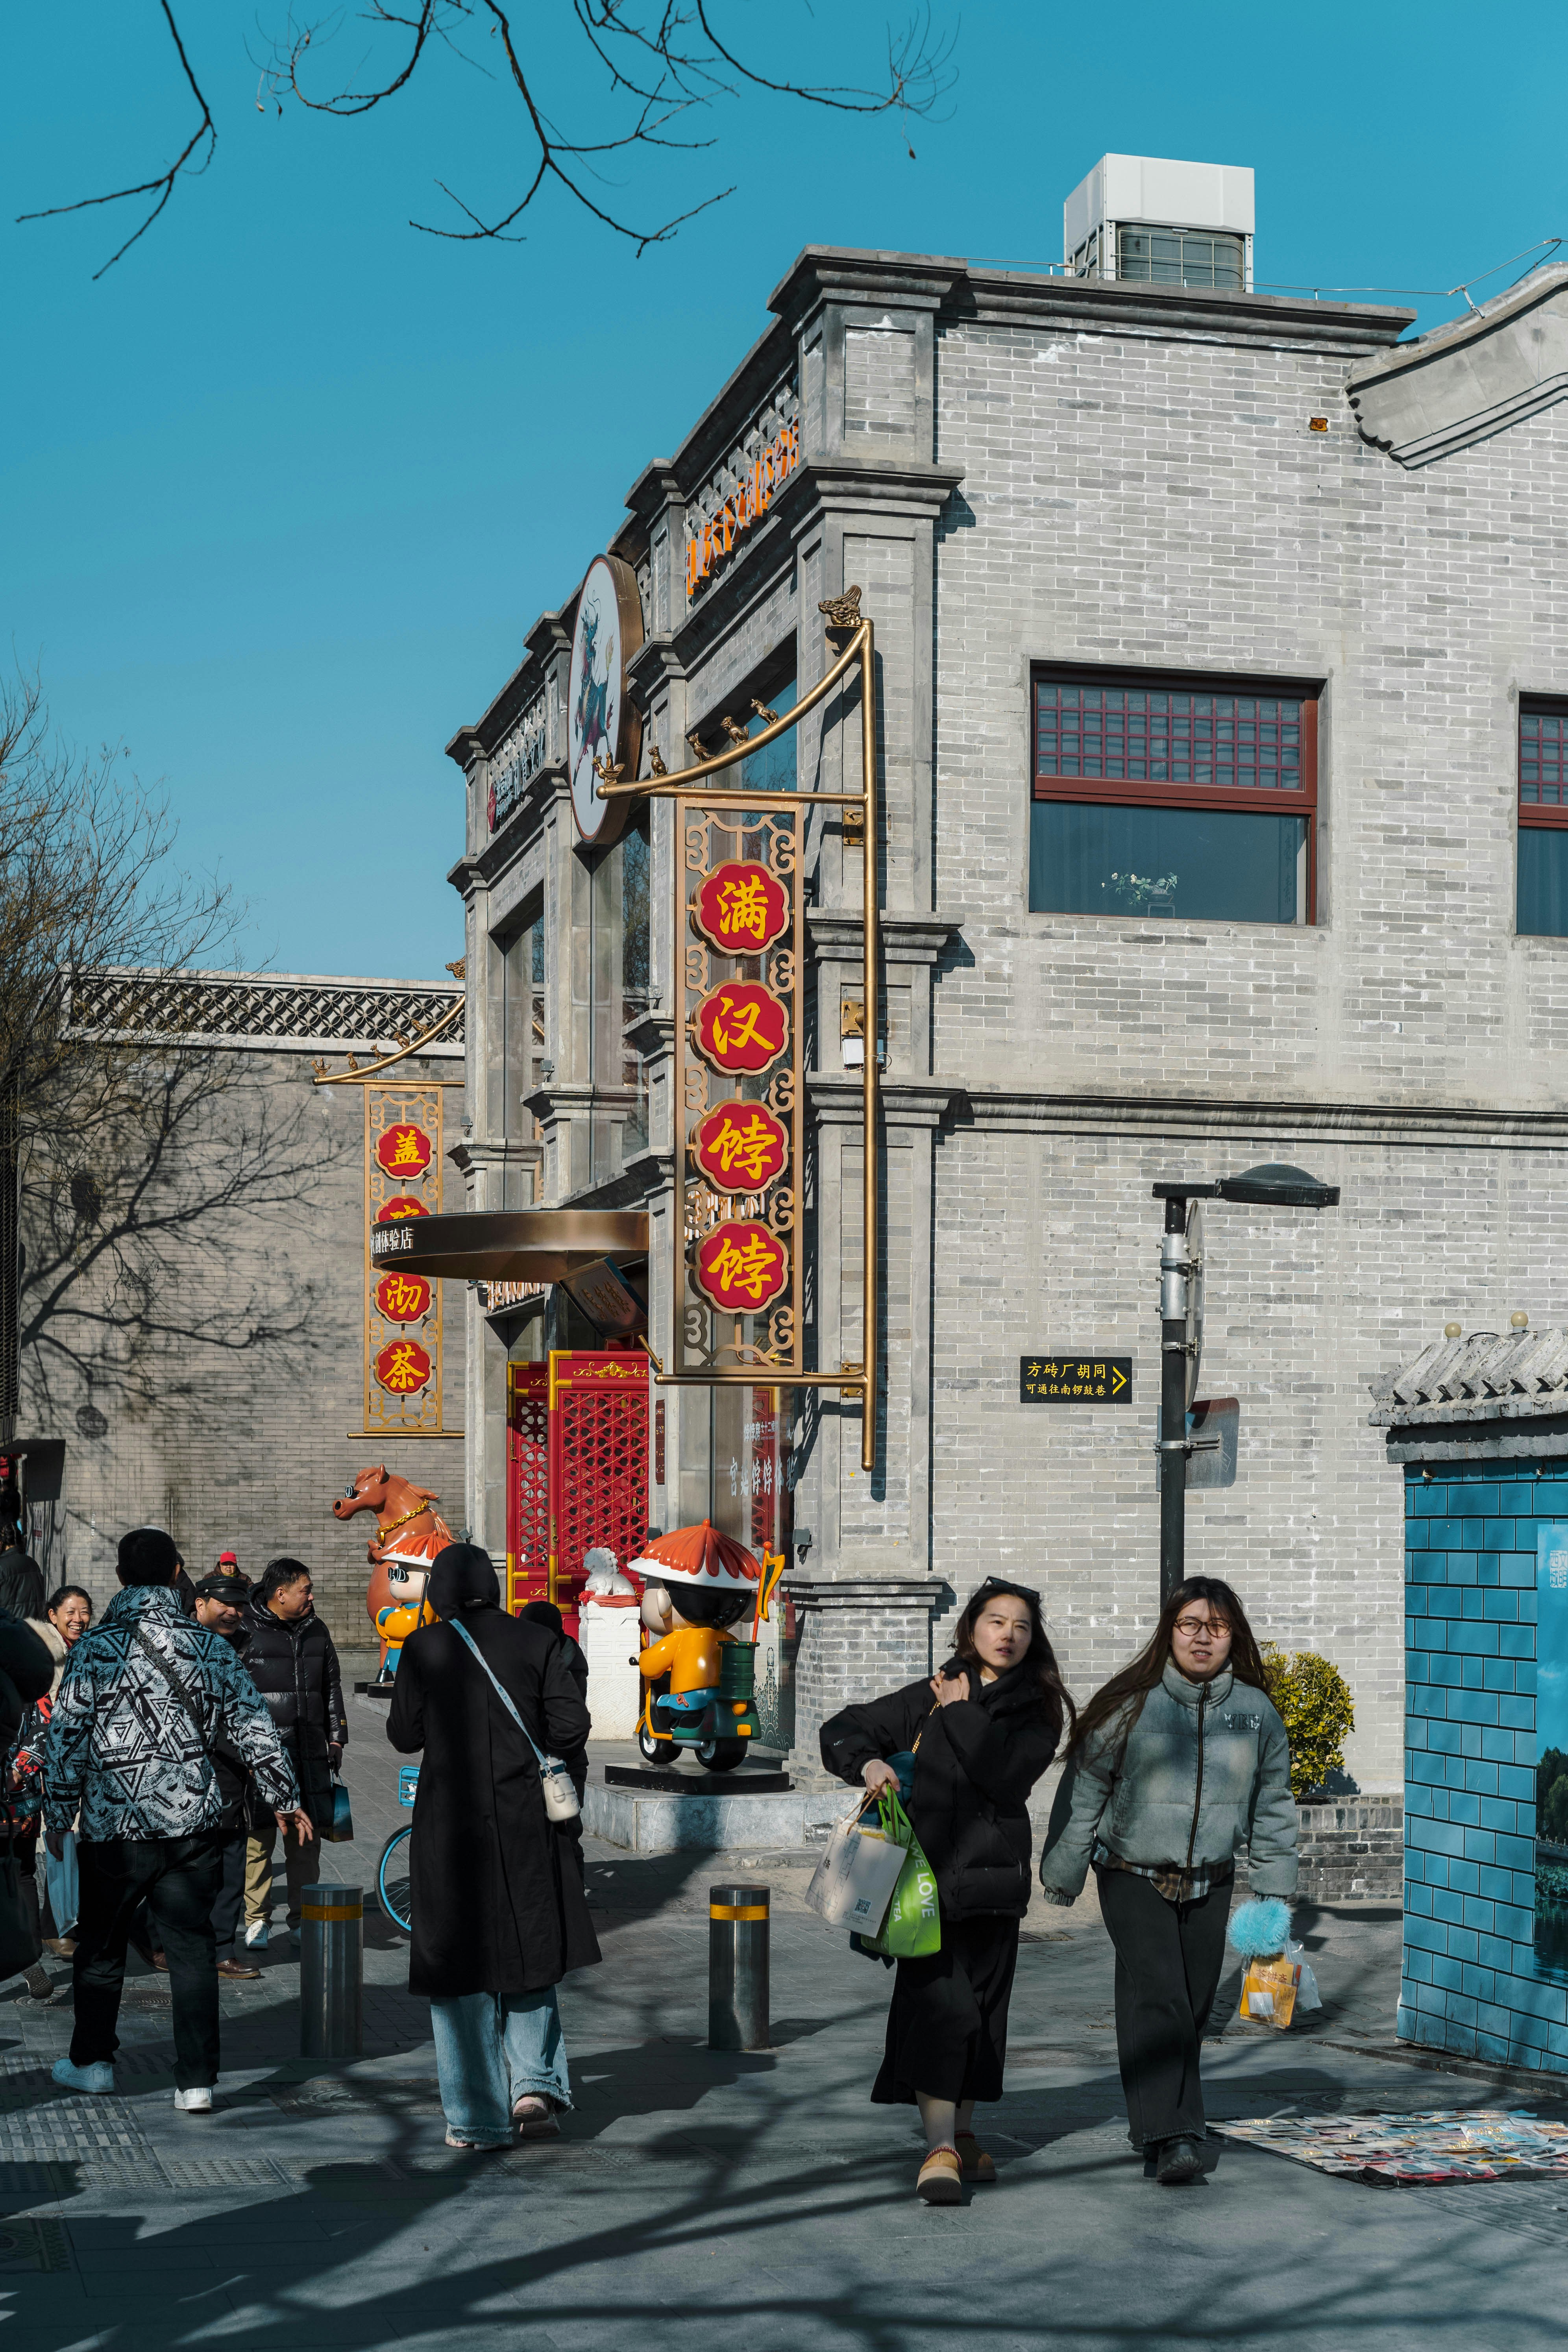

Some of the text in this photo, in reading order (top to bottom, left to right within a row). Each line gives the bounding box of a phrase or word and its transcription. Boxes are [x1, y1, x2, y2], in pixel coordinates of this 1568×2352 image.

[708, 874, 777, 1298] 满汉饽饽
[1027, 1362, 1106, 1379] 方砖厂胡同
[1026, 1383, 1106, 1396] 可通往南锣鼓巷
[909, 1842, 936, 1919] WE LOVE
[893, 1900, 902, 1922] TEA
